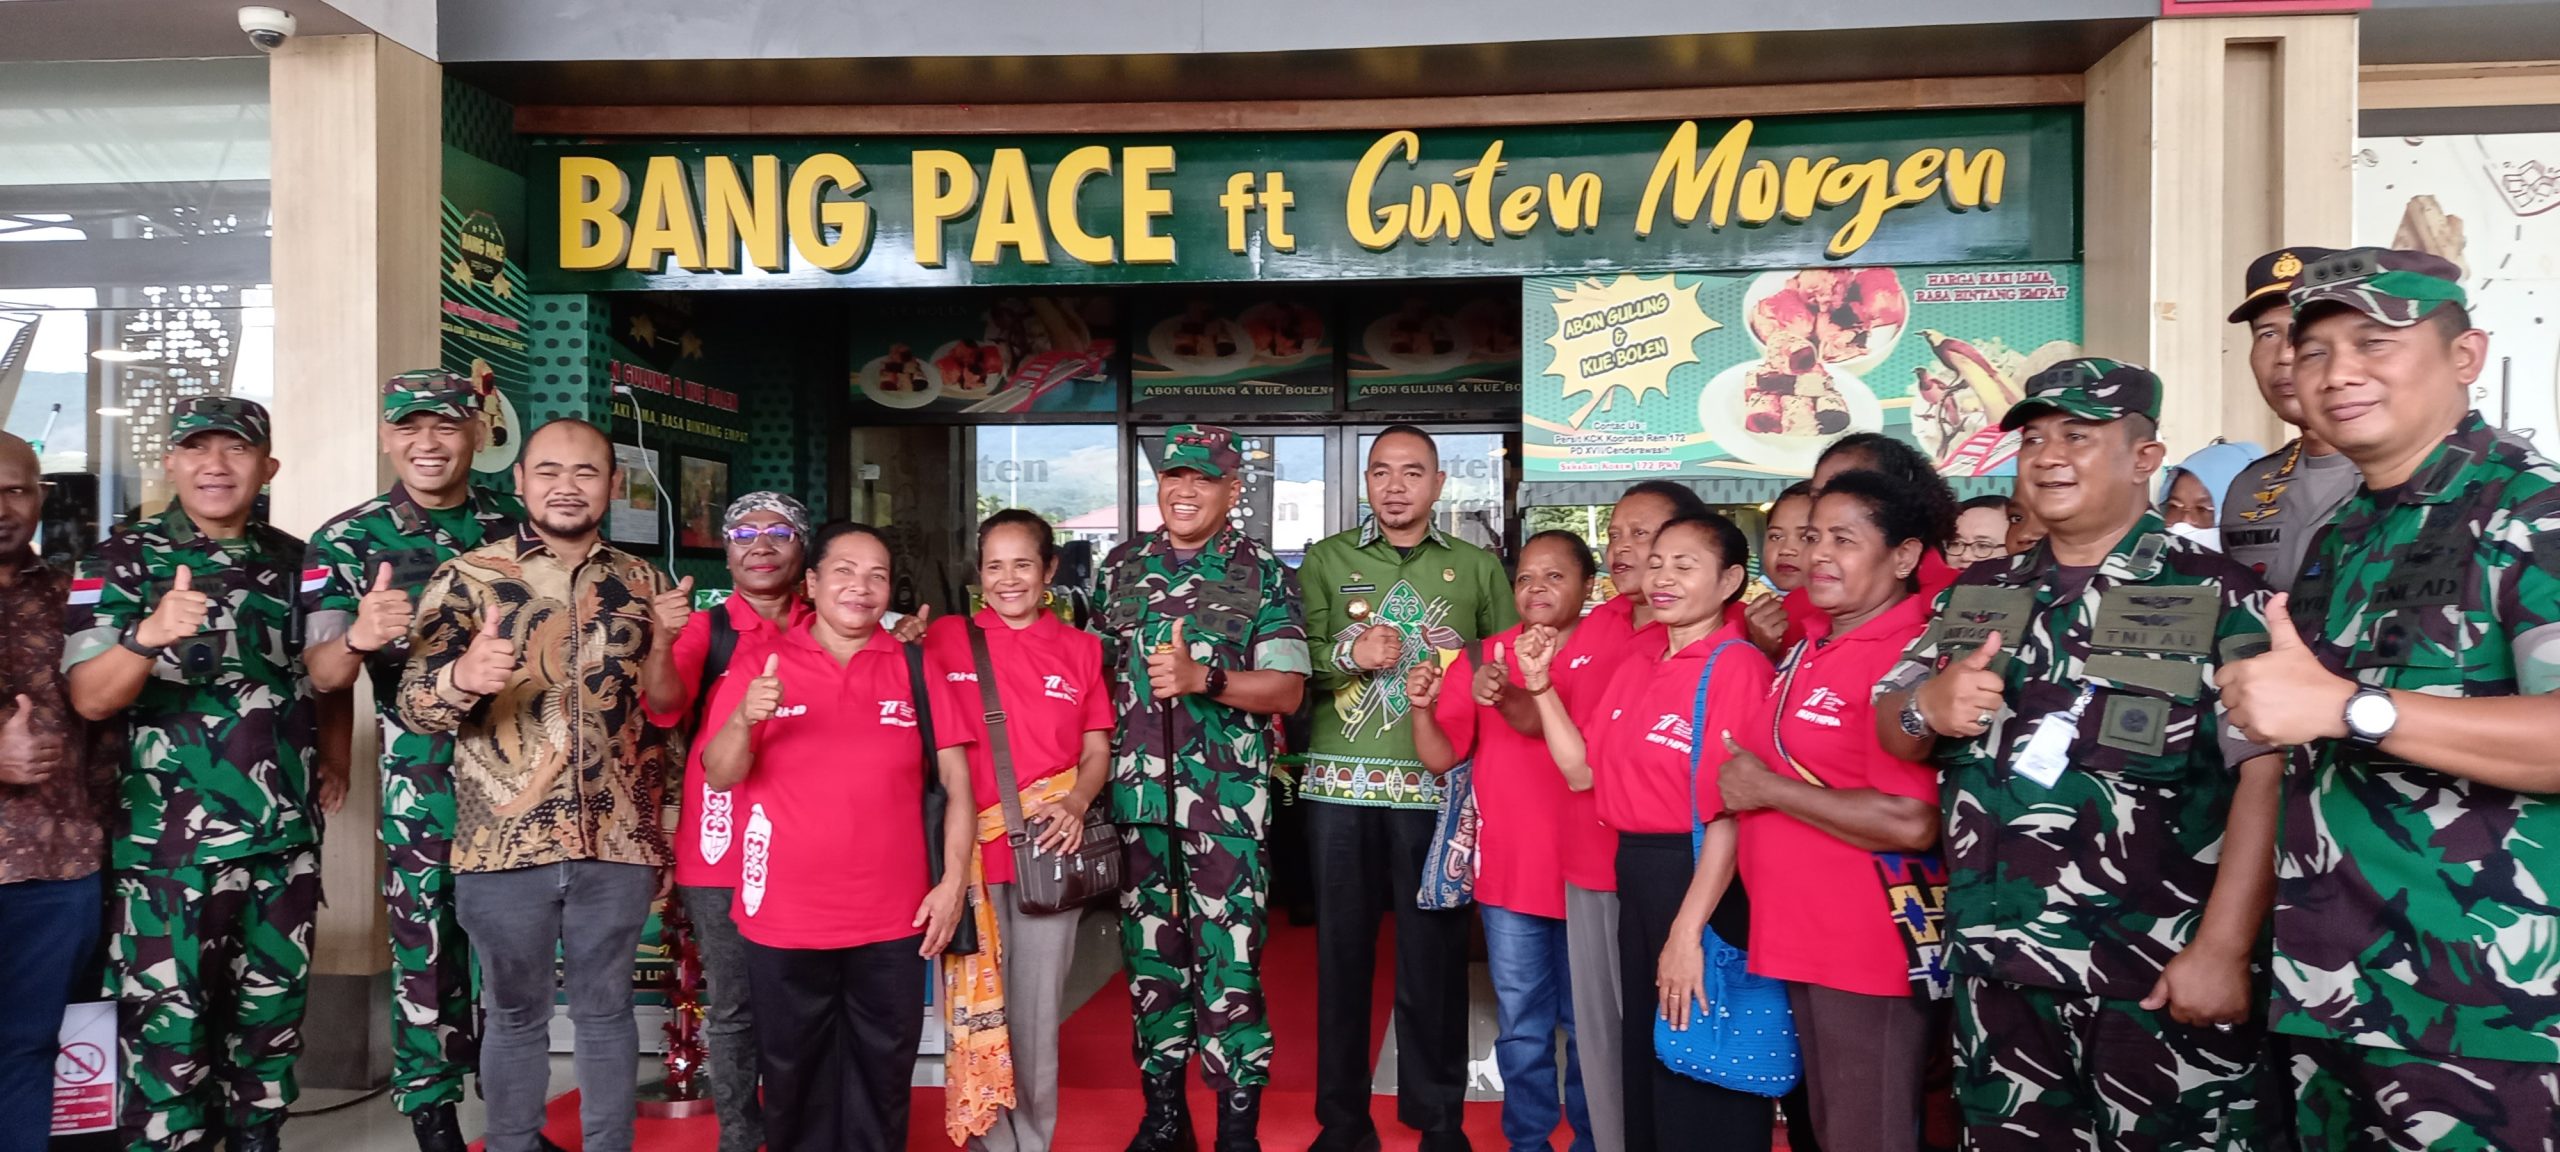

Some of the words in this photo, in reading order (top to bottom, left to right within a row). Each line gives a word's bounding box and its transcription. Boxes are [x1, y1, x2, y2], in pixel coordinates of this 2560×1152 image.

[559, 151, 872, 273] BANG
[911, 145, 1175, 267] PACE
[1219, 170, 1296, 254] ft
[1347, 129, 1603, 251] Guten
[1634, 119, 2006, 260] Morgen
[1927, 274, 1976, 286] HARGA
[1978, 273, 2013, 285] KAKI
[1915, 290, 1950, 302] RASA
[1953, 288, 2016, 301] BINTANG
[2018, 287, 2067, 300] EMPAT
[1564, 311, 1606, 340] ABON
[1606, 293, 1670, 327] GULUNG
[1613, 327, 1627, 347] &
[1580, 351, 1615, 379] KUE
[1614, 336, 1669, 368] BOLEN
[1144, 386, 1181, 396] ABON
[1184, 386, 1236, 396] GULUNG
[1240, 386, 1250, 396] &
[1255, 385, 1281, 395] KUE
[1360, 384, 1397, 395] ABON
[1401, 384, 1454, 394] GULUNG
[1458, 384, 1468, 393] &
[1473, 383, 1500, 393] KUE
[661, 412, 684, 430] RASA
[1669, 433, 1686, 442] 172
[2106, 629, 2148, 645] TNI
[2160, 632, 2197, 647] AU
